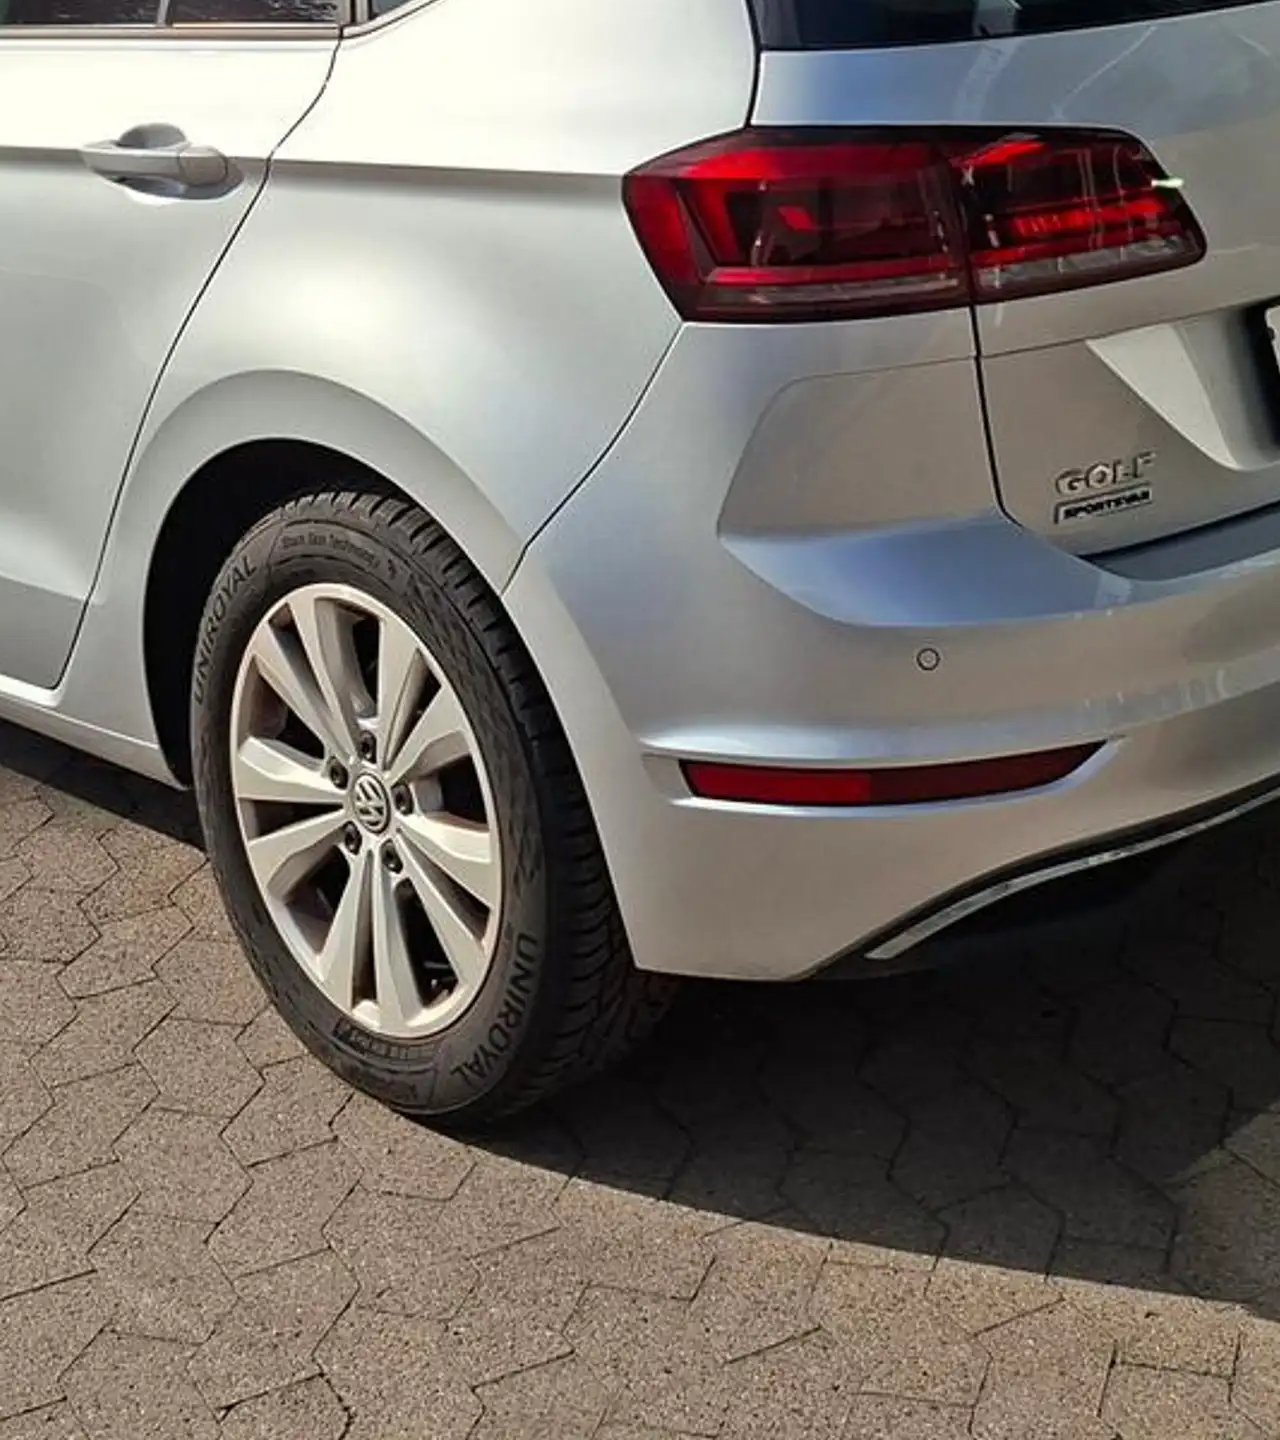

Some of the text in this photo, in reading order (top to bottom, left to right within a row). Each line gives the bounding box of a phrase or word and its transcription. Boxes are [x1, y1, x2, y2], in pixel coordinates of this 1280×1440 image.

[1055, 450, 1157, 494] GOLF
[193, 555, 257, 705] UNIROYAL
[450, 930, 539, 1086] UNIROYAL
